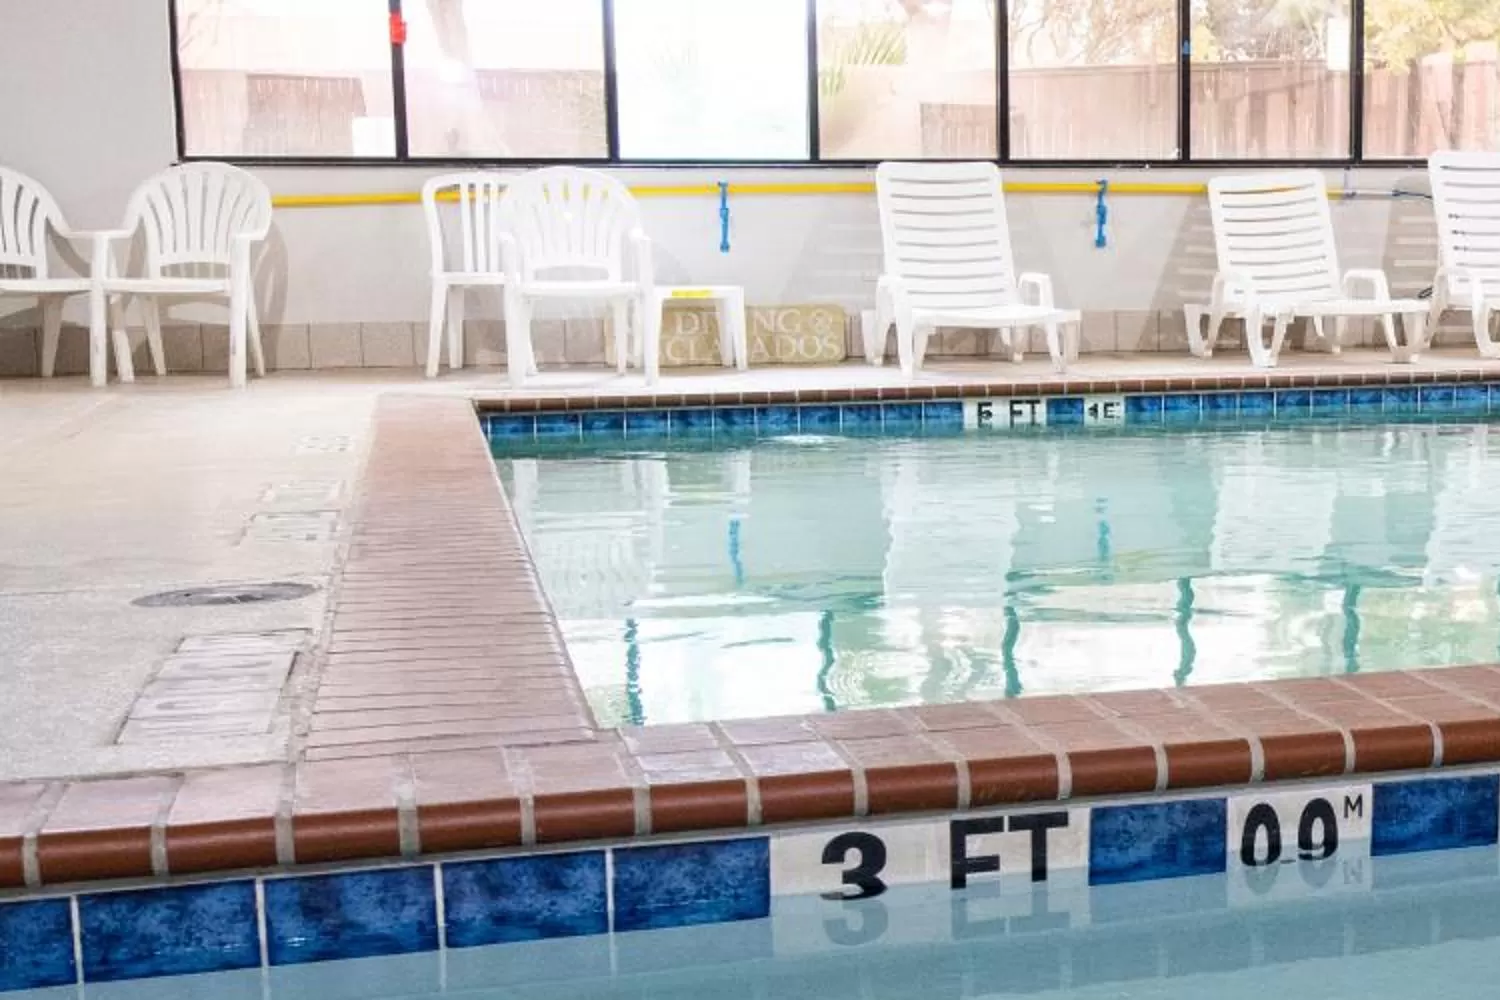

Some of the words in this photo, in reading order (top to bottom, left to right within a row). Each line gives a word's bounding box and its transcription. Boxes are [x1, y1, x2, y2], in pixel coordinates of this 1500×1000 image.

[1010, 399, 1041, 420] FT
[820, 831, 888, 900] 3
[950, 811, 1069, 889] FT
